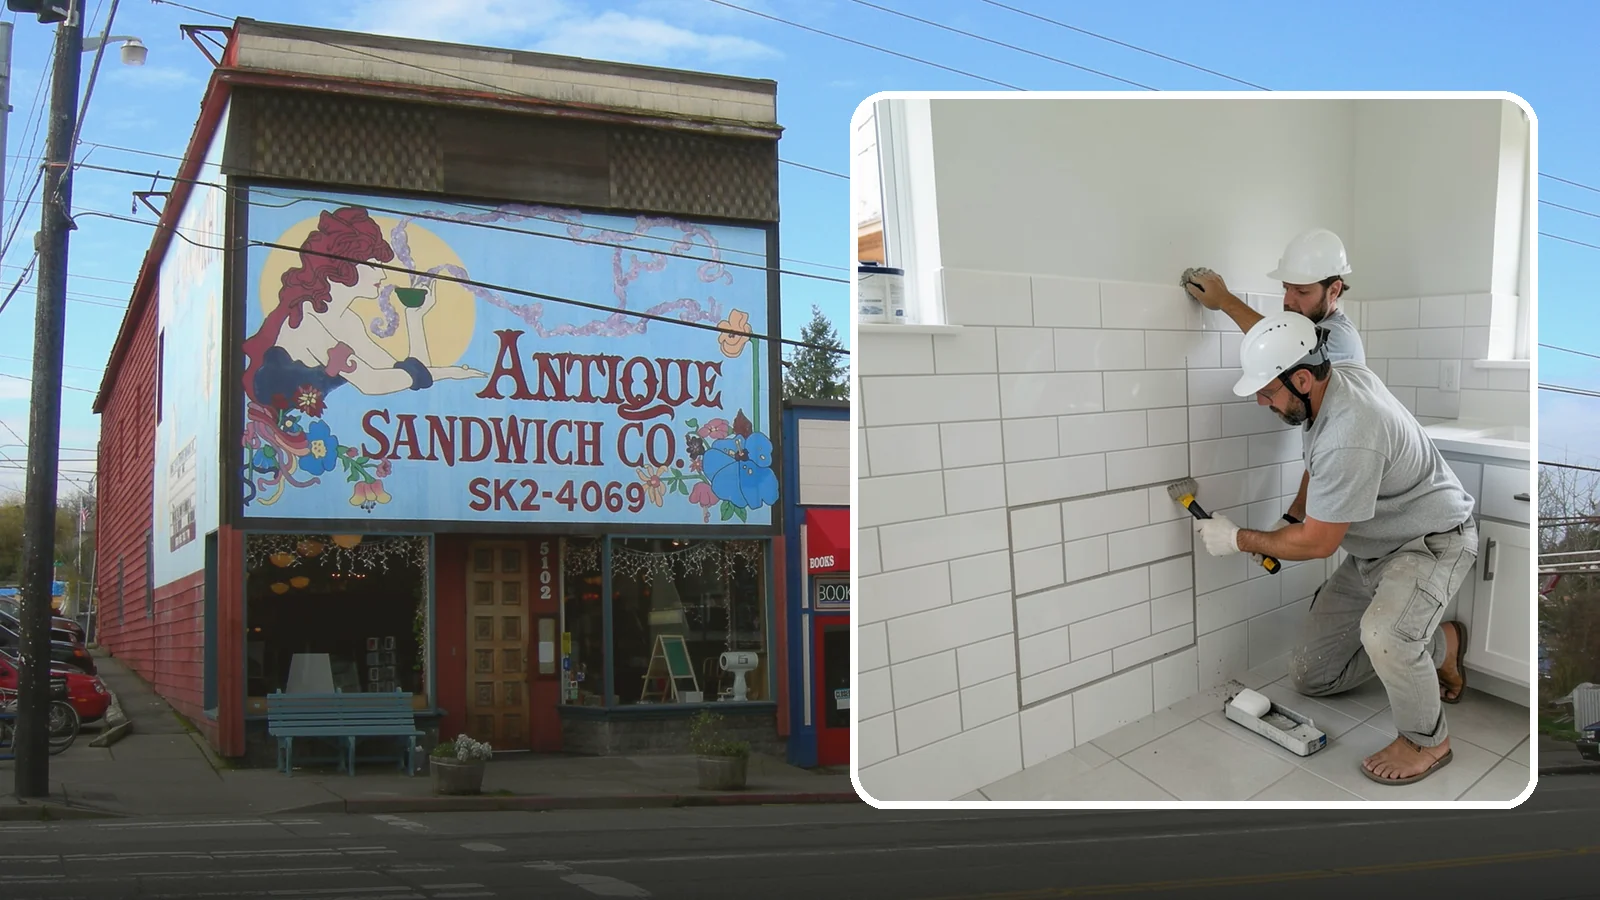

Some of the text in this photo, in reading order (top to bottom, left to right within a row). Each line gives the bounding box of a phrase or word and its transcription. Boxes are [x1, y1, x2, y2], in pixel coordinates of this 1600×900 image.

[476, 329, 723, 421] ANTIQUE
[361, 408, 685, 469] SANDWICH CO.
[468, 477, 645, 513] SK2-4069
[540, 541, 551, 600] 5102
[809, 555, 835, 569] BOOKS
